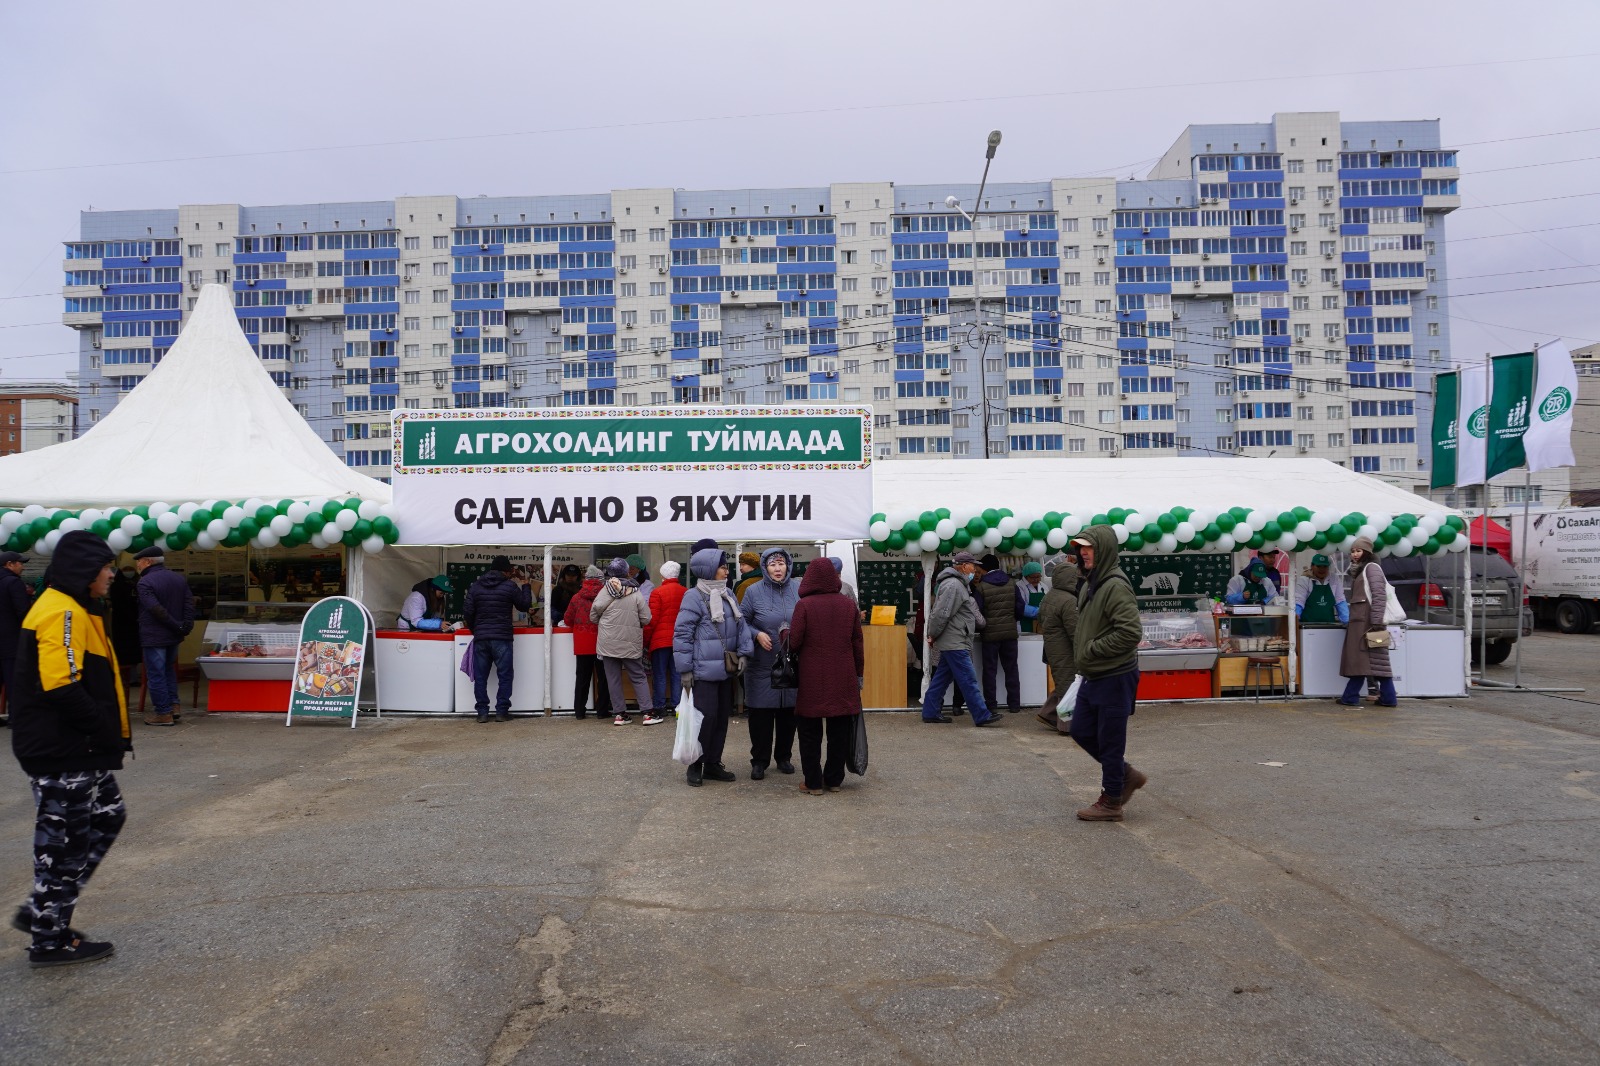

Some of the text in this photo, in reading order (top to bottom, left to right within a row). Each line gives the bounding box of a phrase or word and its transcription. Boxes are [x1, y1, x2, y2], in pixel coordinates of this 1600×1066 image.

[454, 424, 845, 457] АГРОХОЛДИНГ ТУЙМААДА
[454, 494, 812, 530] СДЕЛАНО В ЯКУТИИ
[477, 553, 527, 562] Агродинг
[528, 554, 574, 562] «Туйаада»
